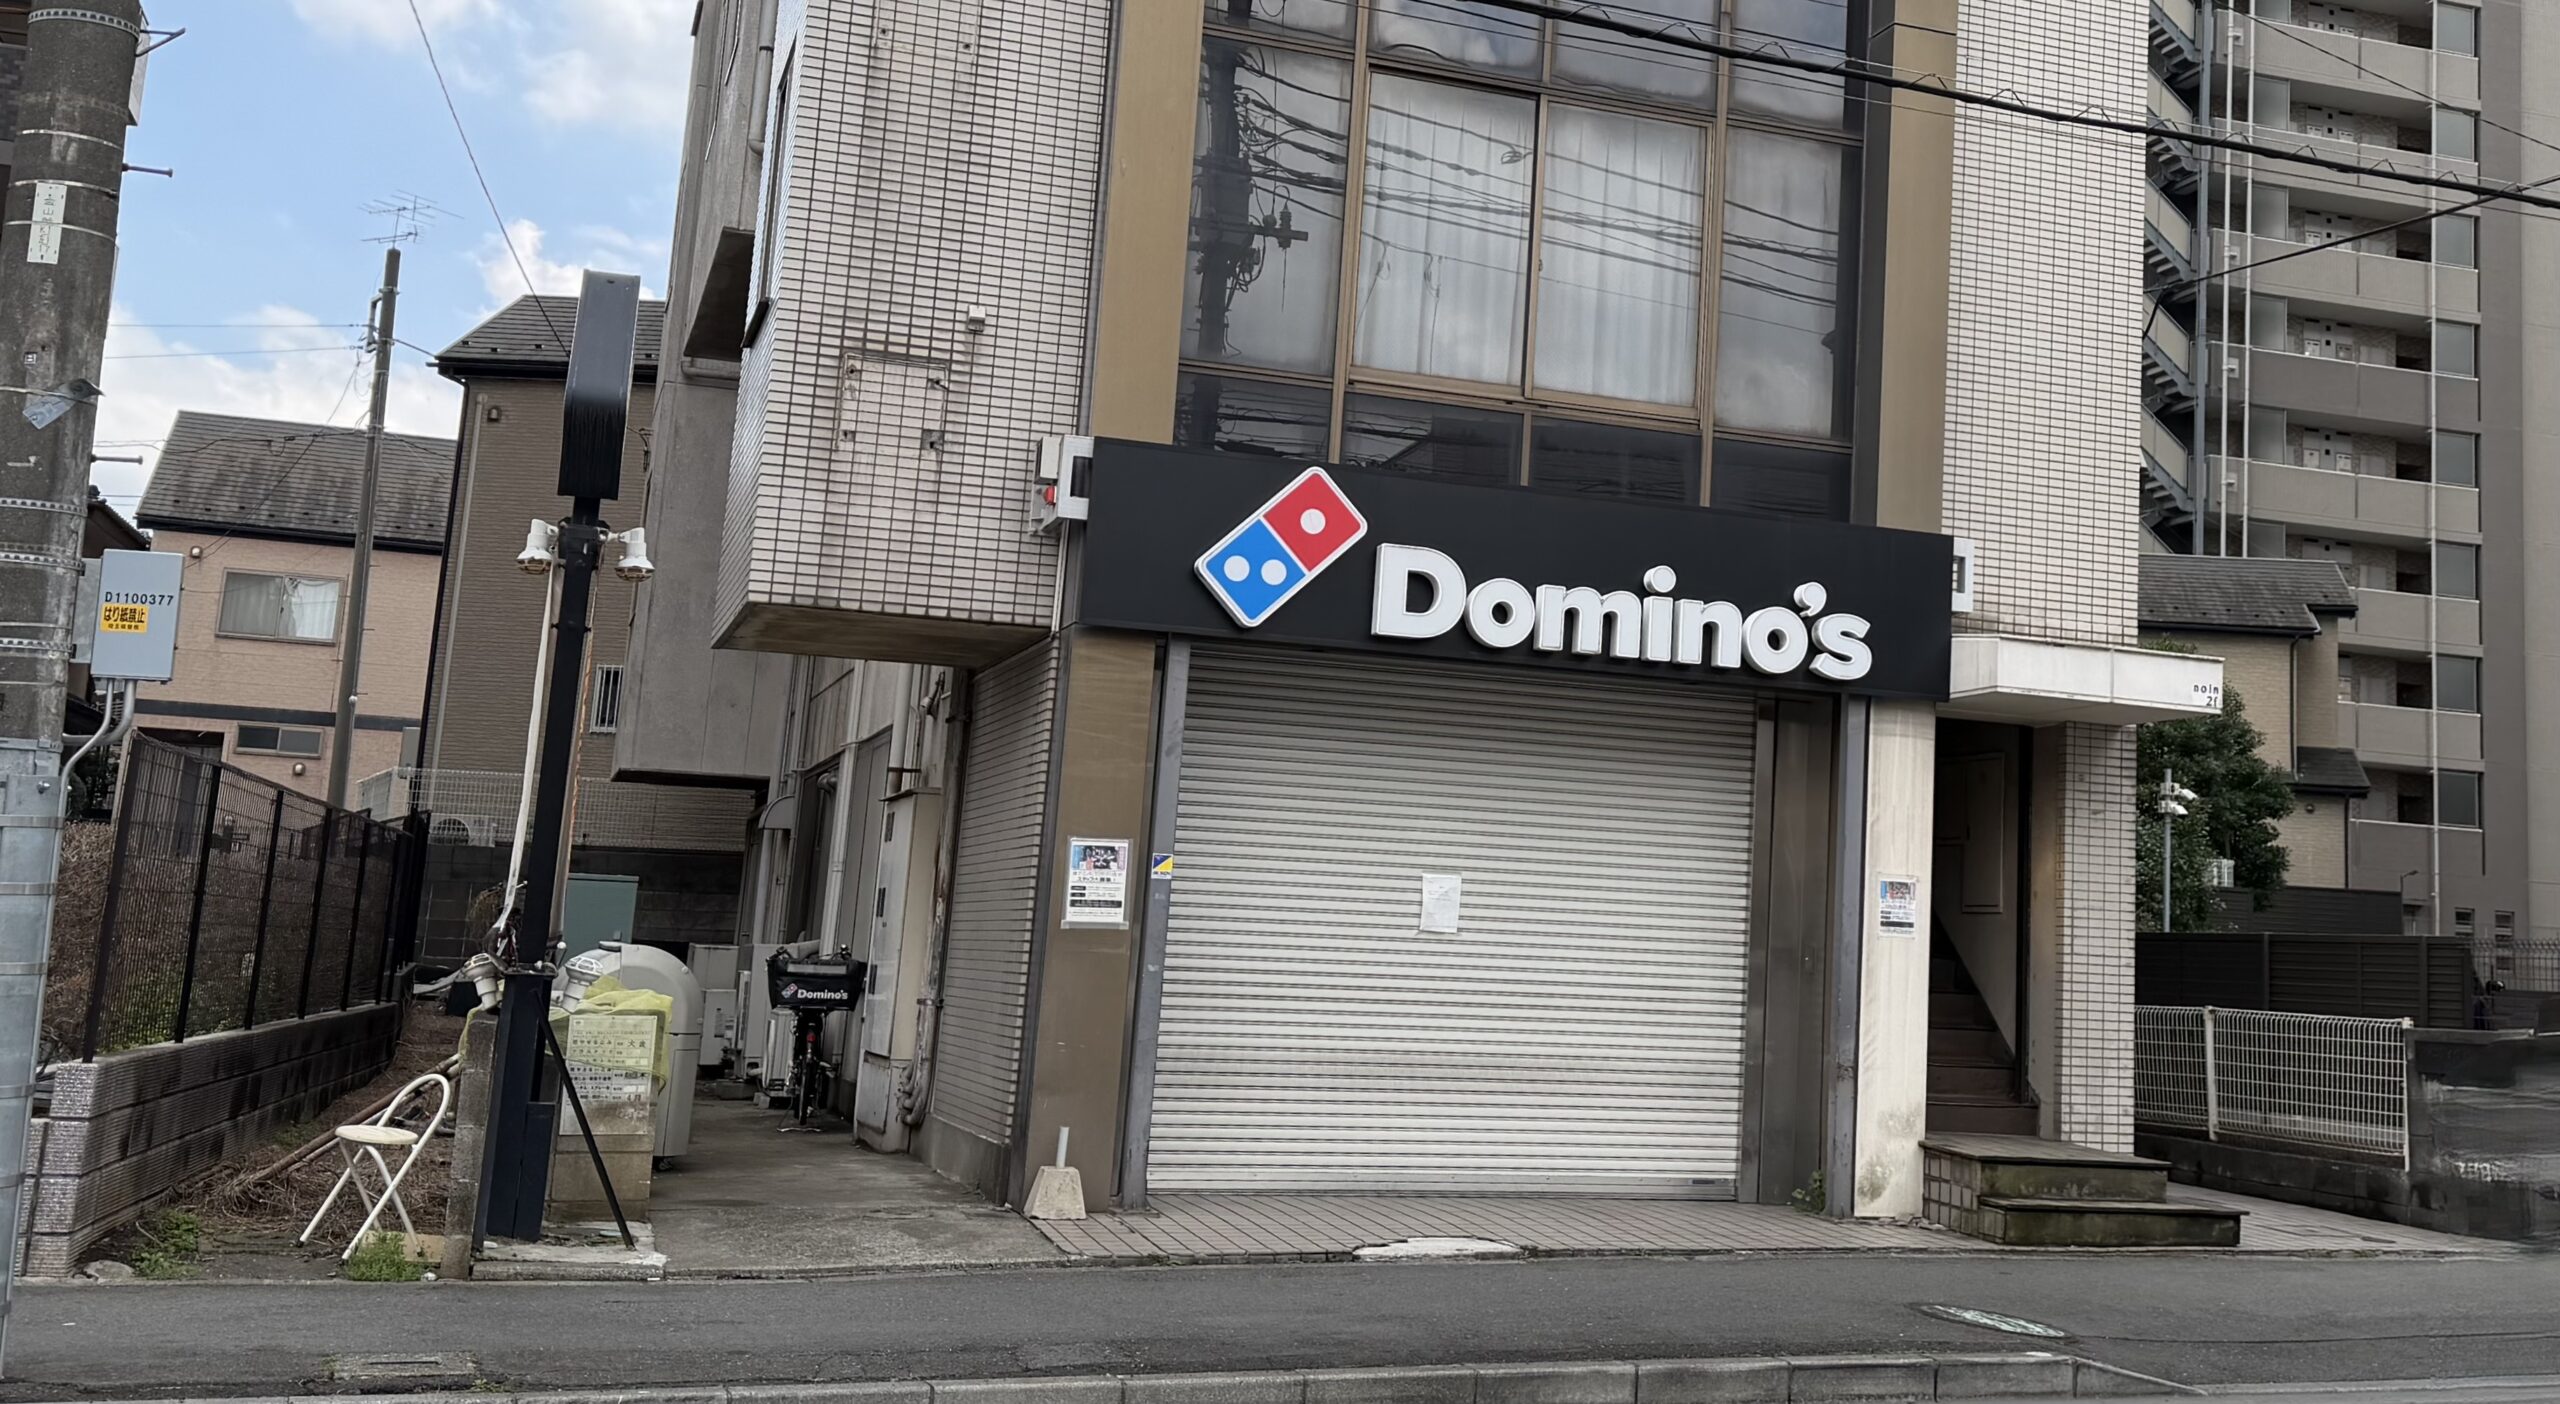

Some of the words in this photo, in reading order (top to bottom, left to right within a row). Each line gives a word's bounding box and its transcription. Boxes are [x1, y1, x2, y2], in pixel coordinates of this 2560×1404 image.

[105, 591, 174, 606] D1100377
[1371, 543, 1873, 681] Domino's
[797, 989, 849, 1000] Domino's
